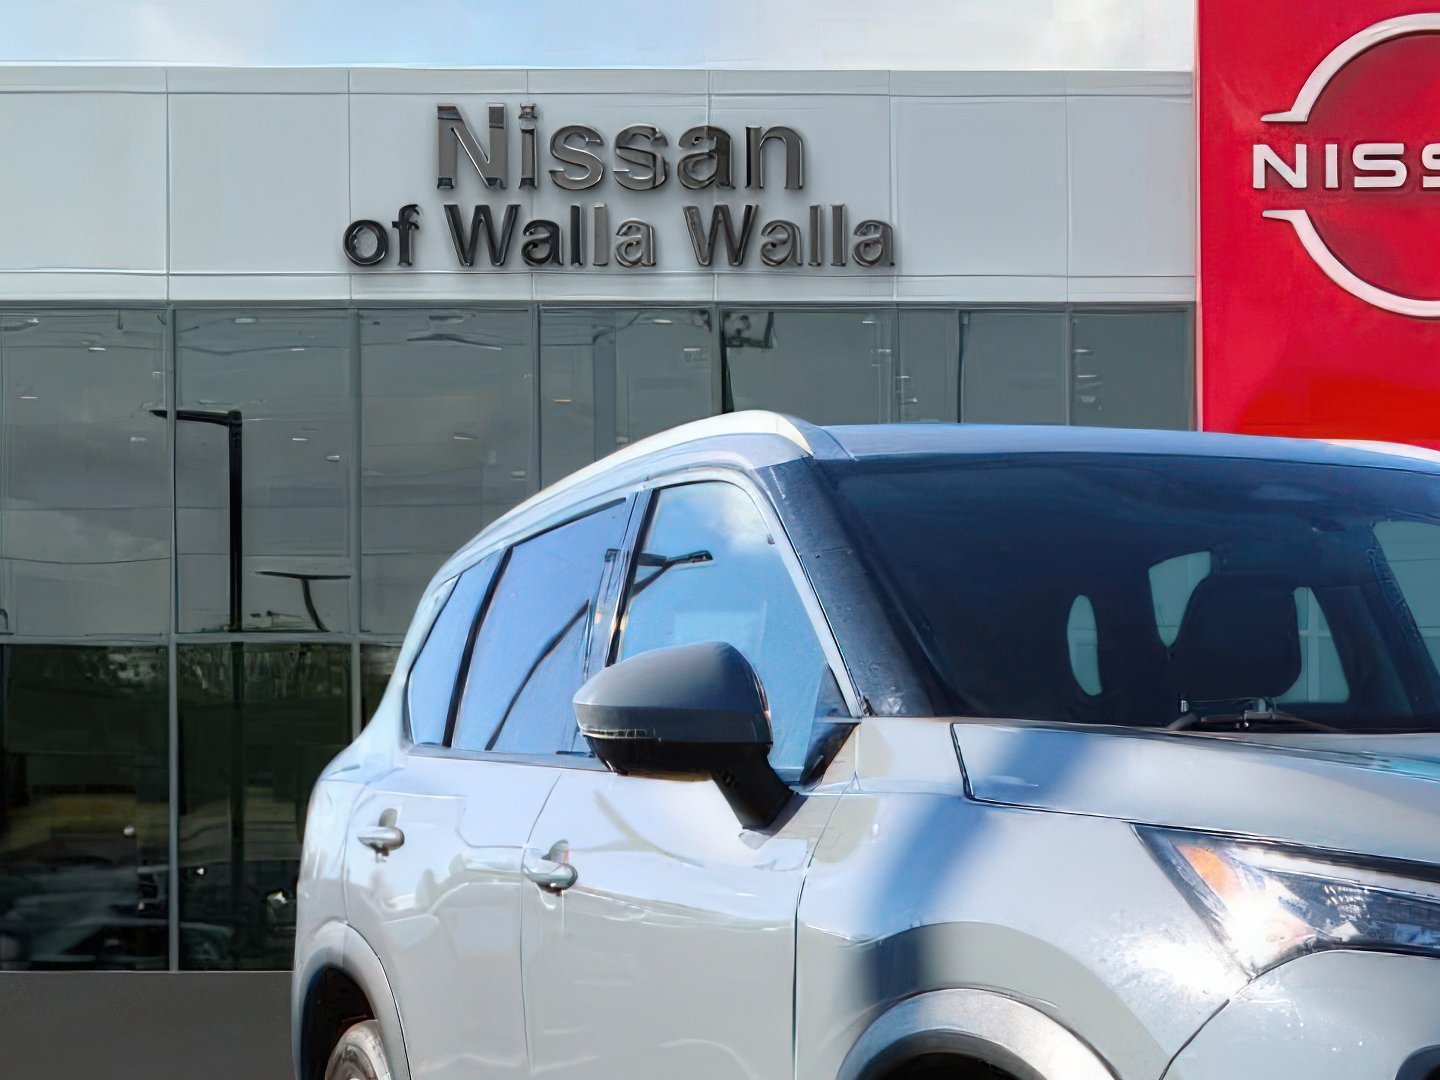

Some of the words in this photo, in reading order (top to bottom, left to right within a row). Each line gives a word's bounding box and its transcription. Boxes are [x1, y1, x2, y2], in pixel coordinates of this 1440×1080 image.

[437, 103, 804, 190] Nissan
[342, 203, 423, 267] of
[443, 203, 657, 267] Walla
[683, 203, 895, 267] Walla
